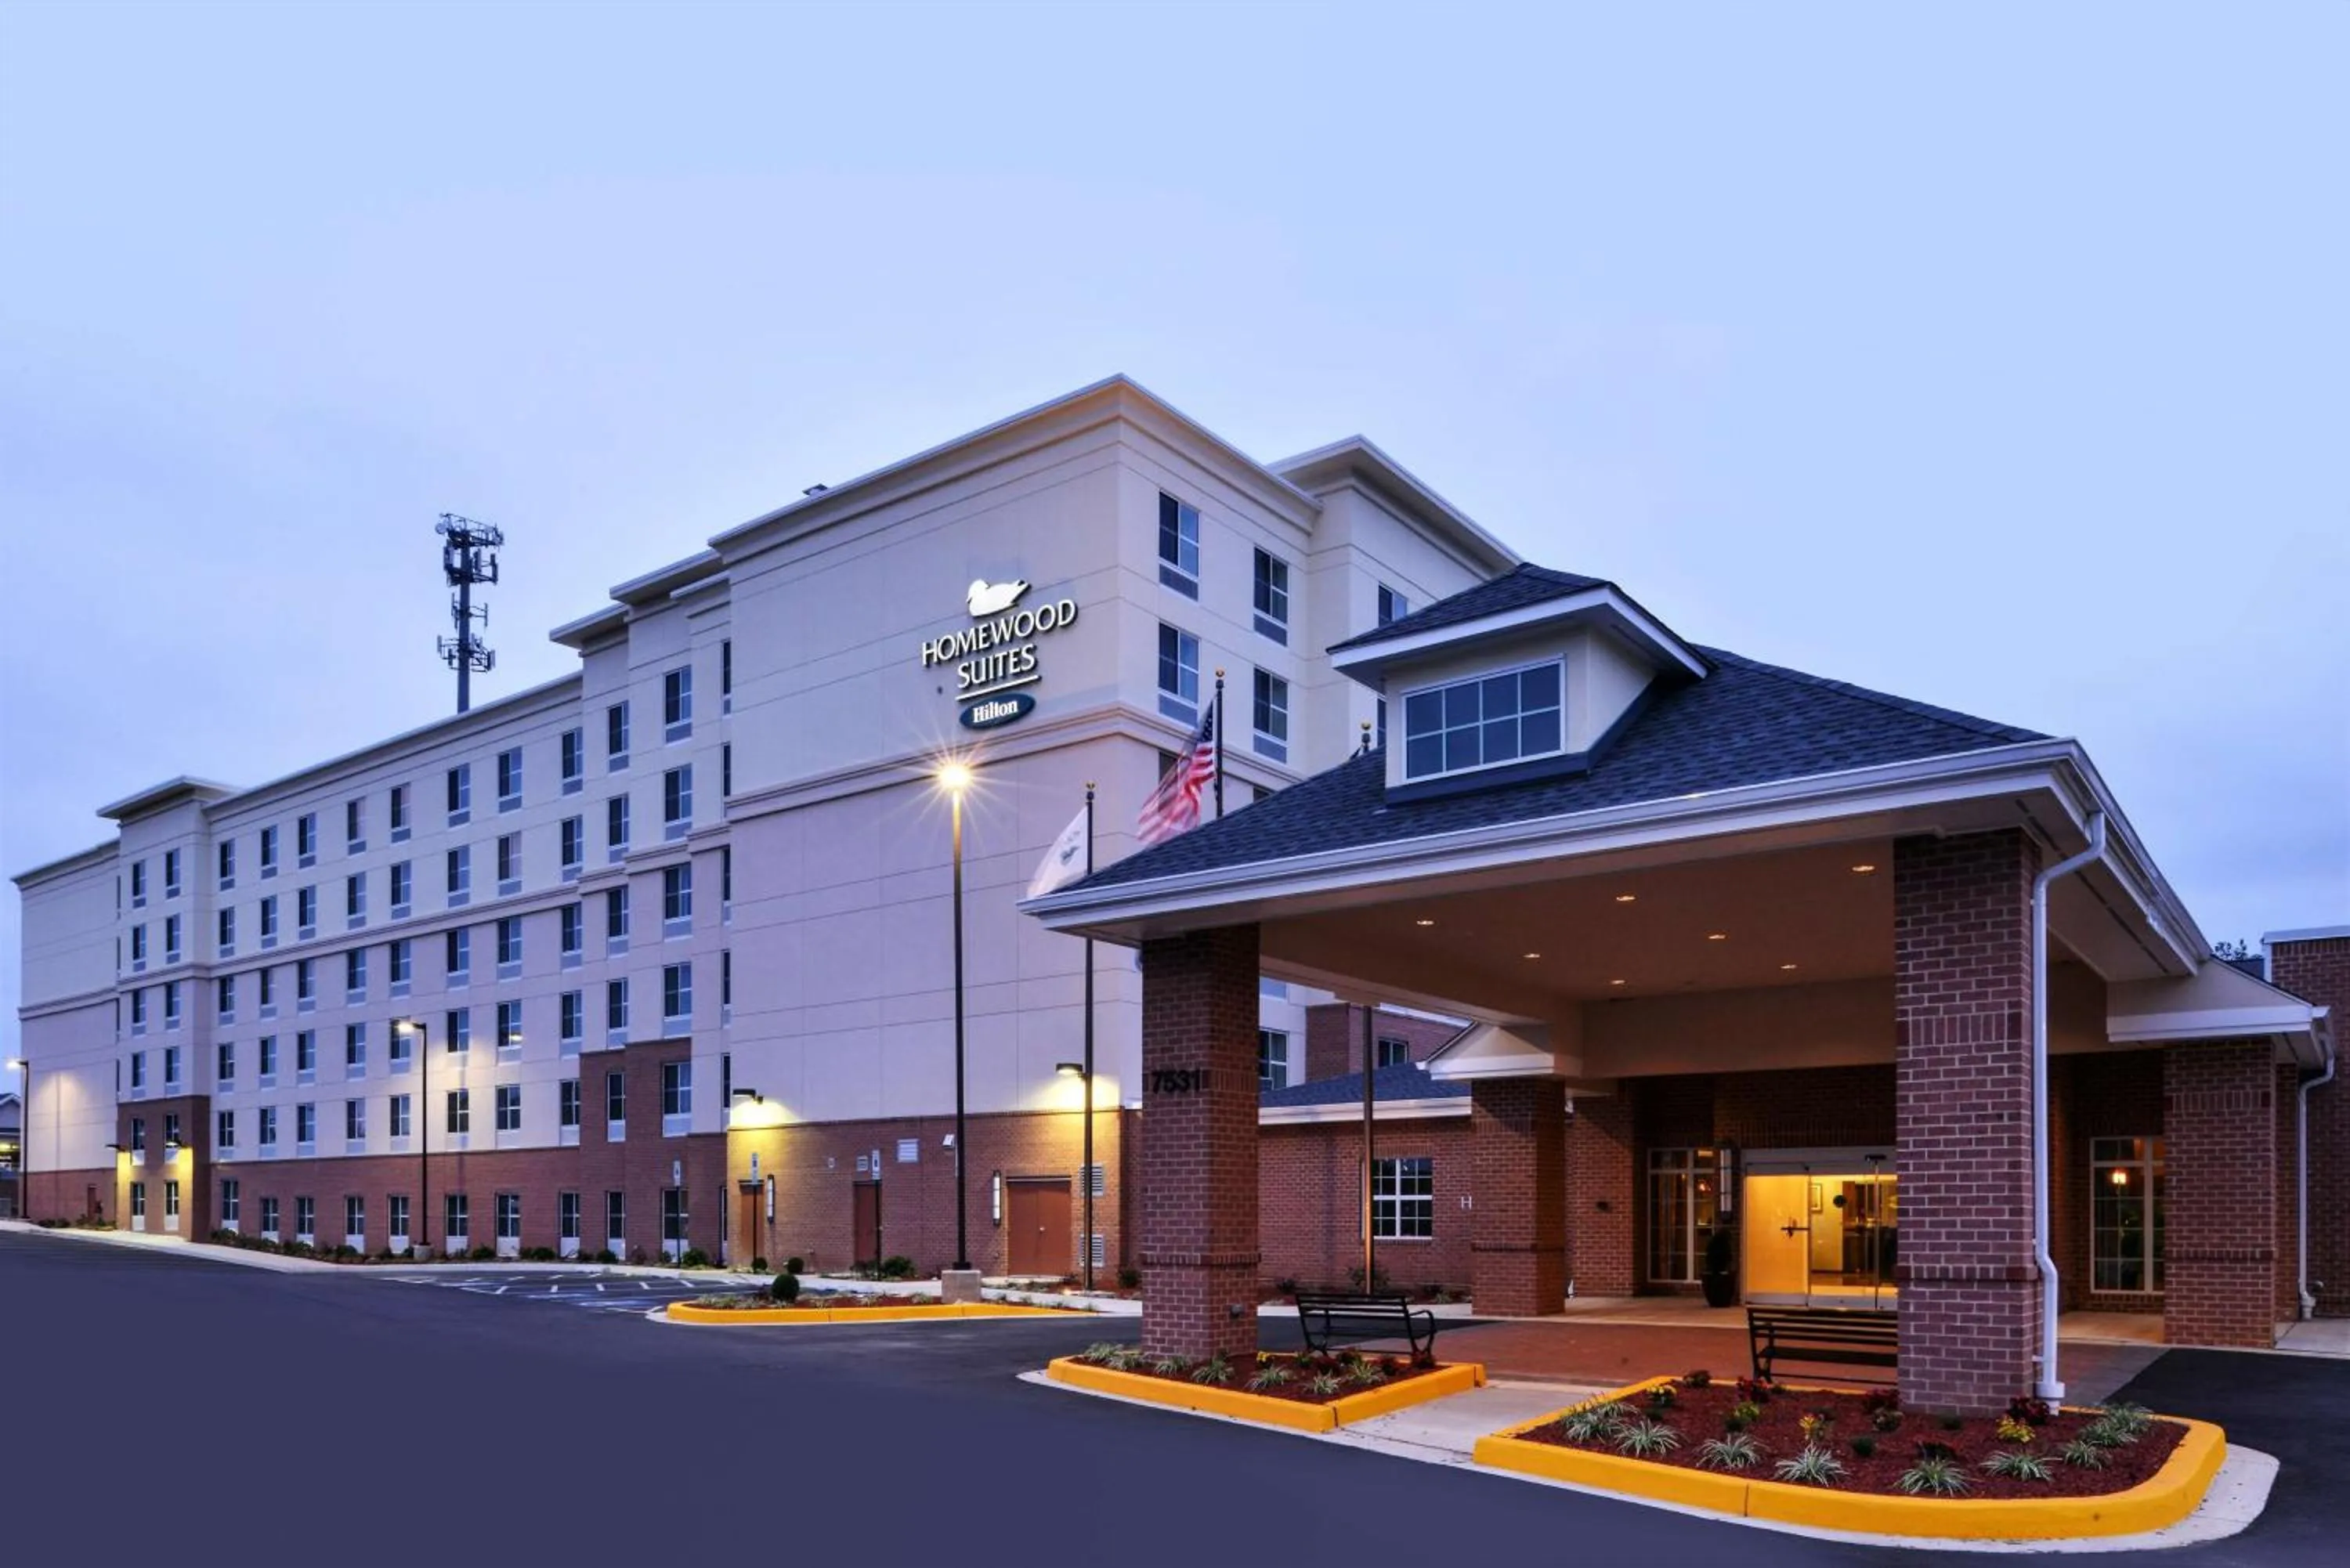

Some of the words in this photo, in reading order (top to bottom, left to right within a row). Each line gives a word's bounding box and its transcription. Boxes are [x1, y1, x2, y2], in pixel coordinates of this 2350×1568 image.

[921, 598, 1078, 667] HOMEWOOD
[956, 643, 1037, 689] SUITES
[972, 700, 1018, 723] Hilton
[1152, 1070, 1200, 1094] 7531
